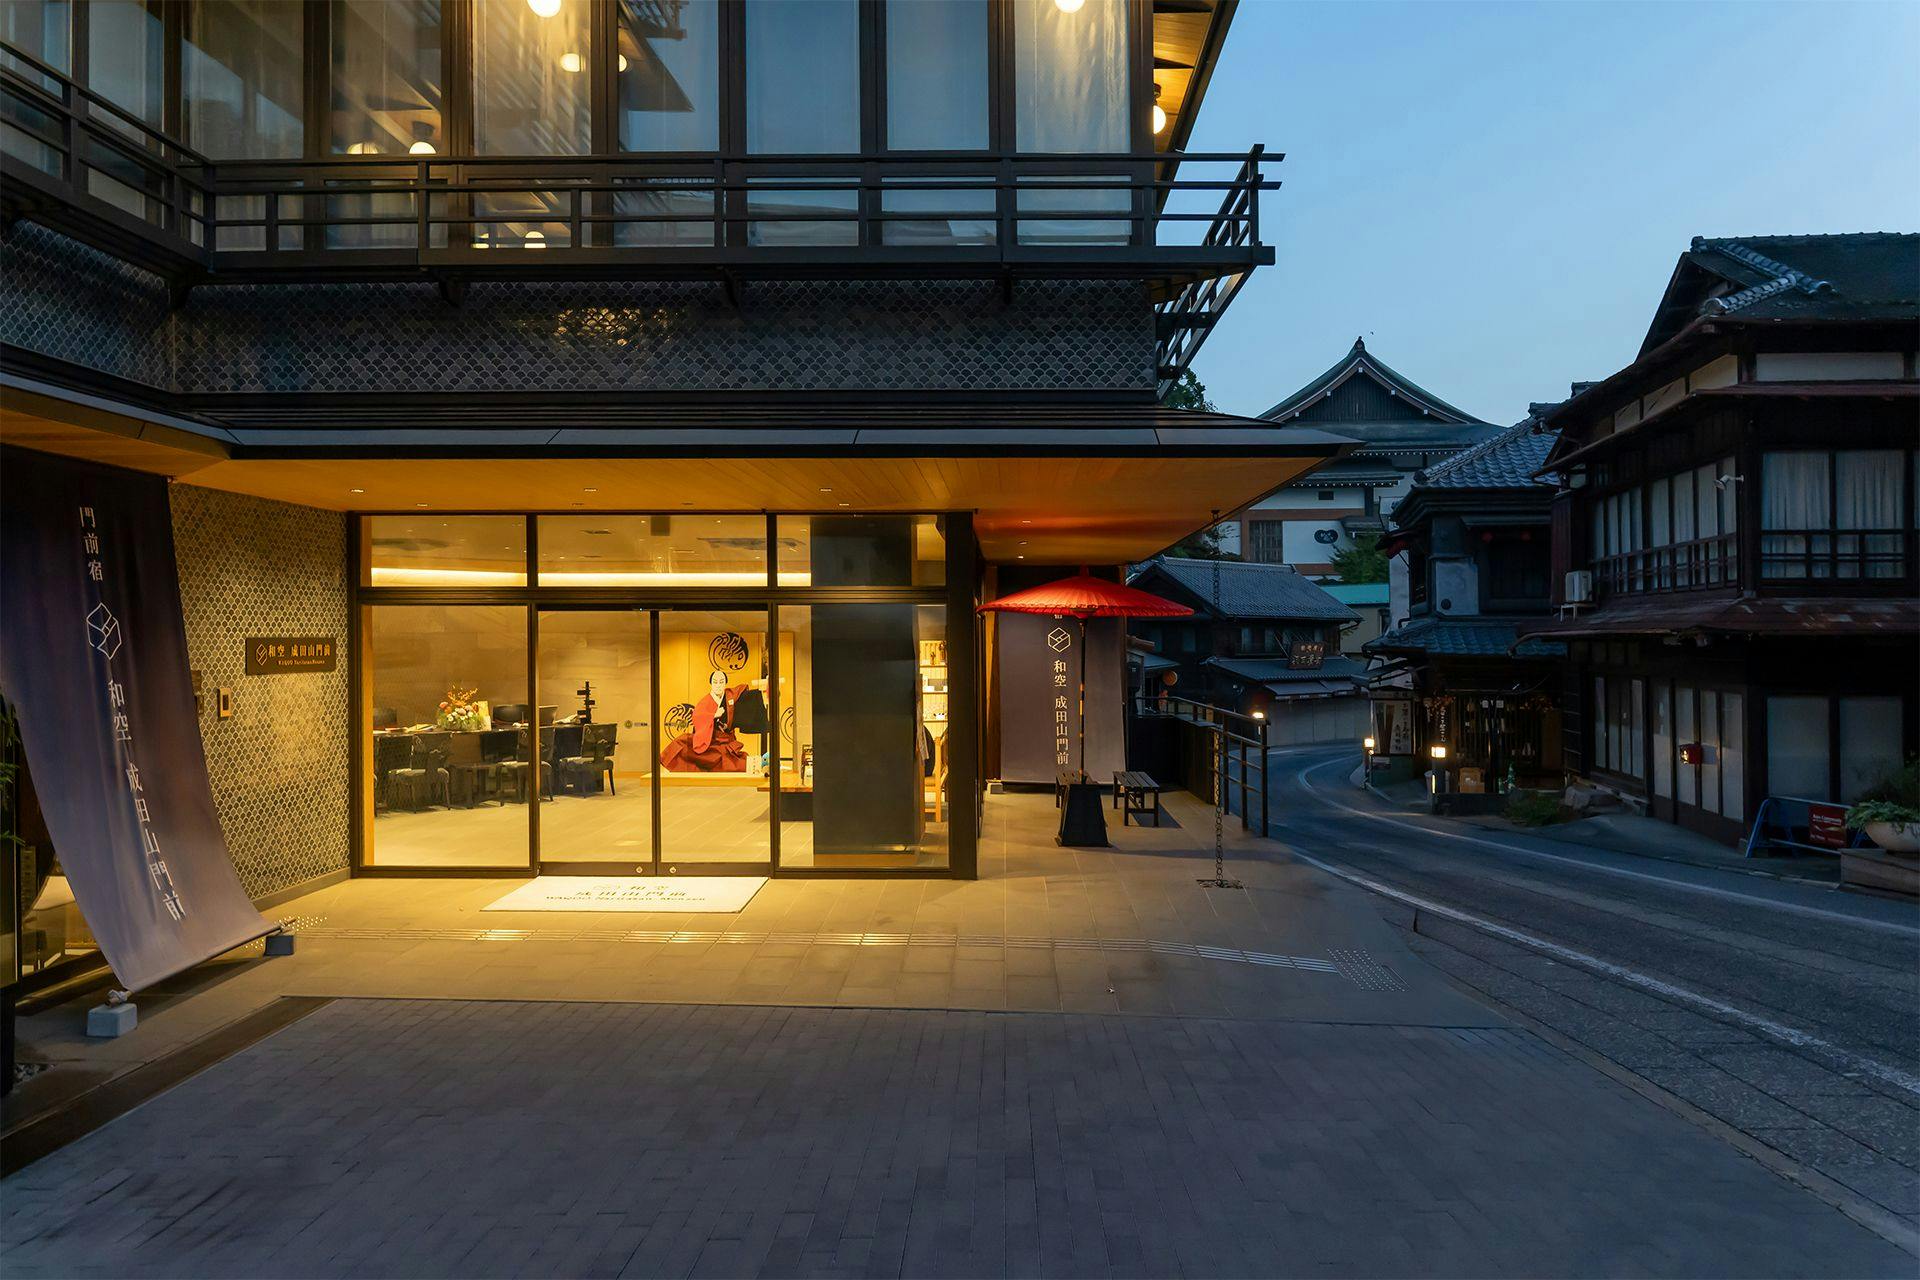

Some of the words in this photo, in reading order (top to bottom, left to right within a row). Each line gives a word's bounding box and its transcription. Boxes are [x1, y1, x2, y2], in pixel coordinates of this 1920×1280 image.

[79, 506, 104, 582] 門前宿
[268, 644, 286, 658] 和空
[291, 644, 331, 658] 成田山門前
[1053, 659, 1067, 688] 和空
[1055, 695, 1069, 766] 成田山門前
[107, 679, 132, 742] 和空
[126, 762, 186, 921] 成田山門前
